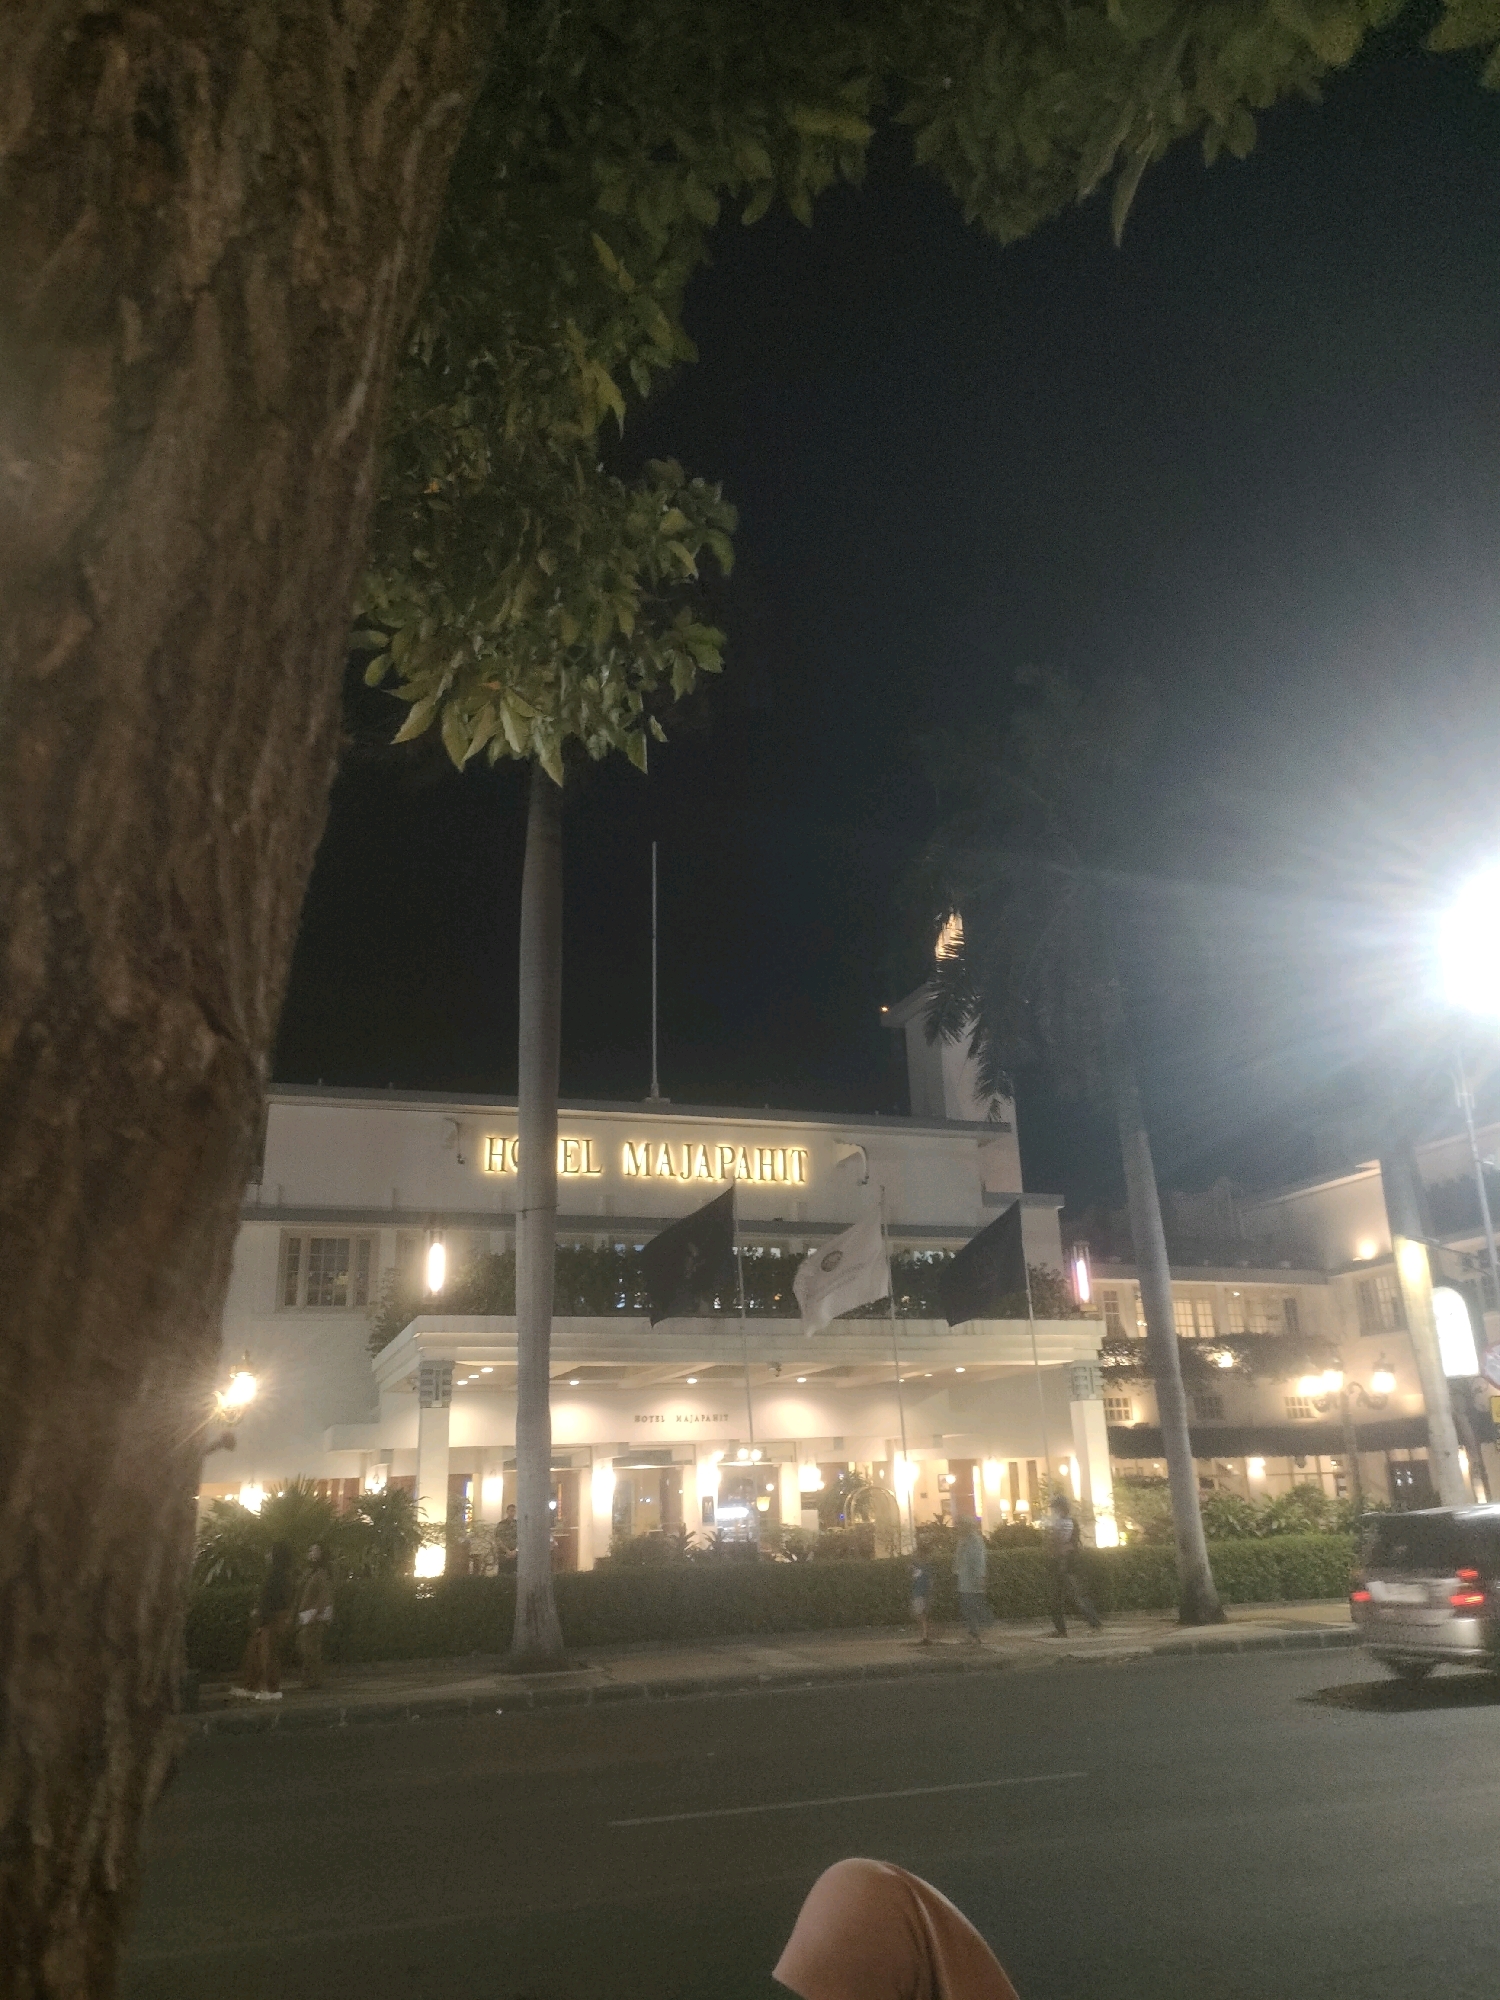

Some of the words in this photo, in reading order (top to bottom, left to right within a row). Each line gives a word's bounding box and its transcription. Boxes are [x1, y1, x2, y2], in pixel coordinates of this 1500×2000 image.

[485, 1136, 603, 1174] HEL
[624, 1141, 809, 1182] MAJAPAHIT
[634, 1415, 665, 1424] HOTEL
[676, 1413, 729, 1424] MAJAPAHIT
